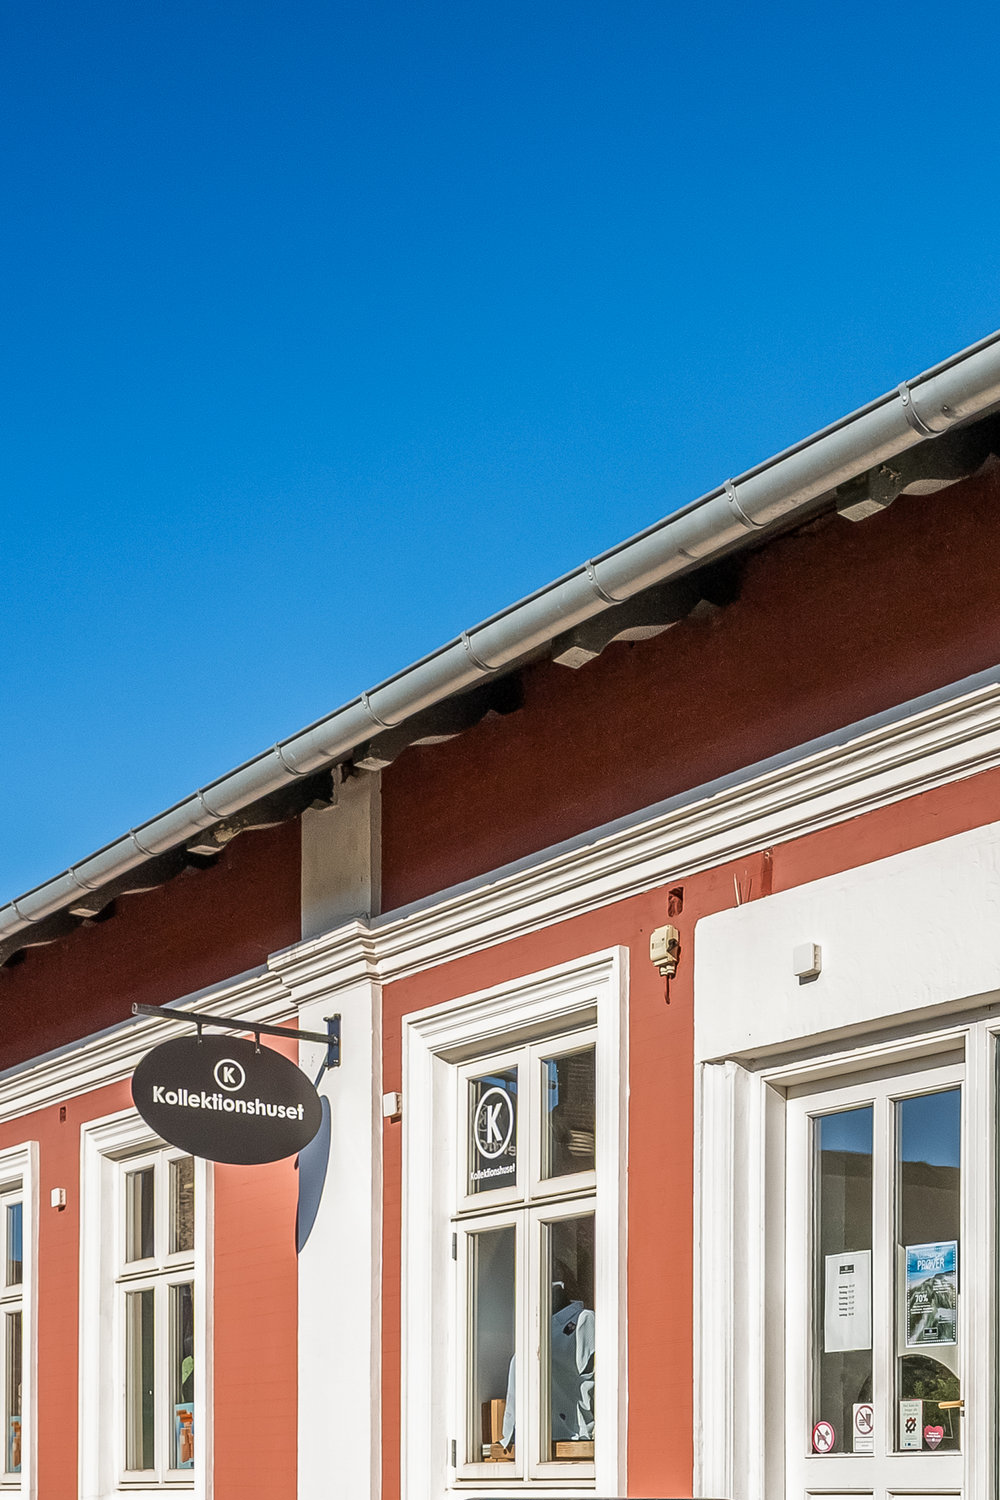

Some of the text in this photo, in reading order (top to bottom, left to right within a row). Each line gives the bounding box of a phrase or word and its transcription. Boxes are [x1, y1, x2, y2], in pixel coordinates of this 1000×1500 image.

[152, 1085, 305, 1121] Kollektionshuset
[486, 1102, 503, 1143] K
[470, 1162, 516, 1180] Kollektionshuset
